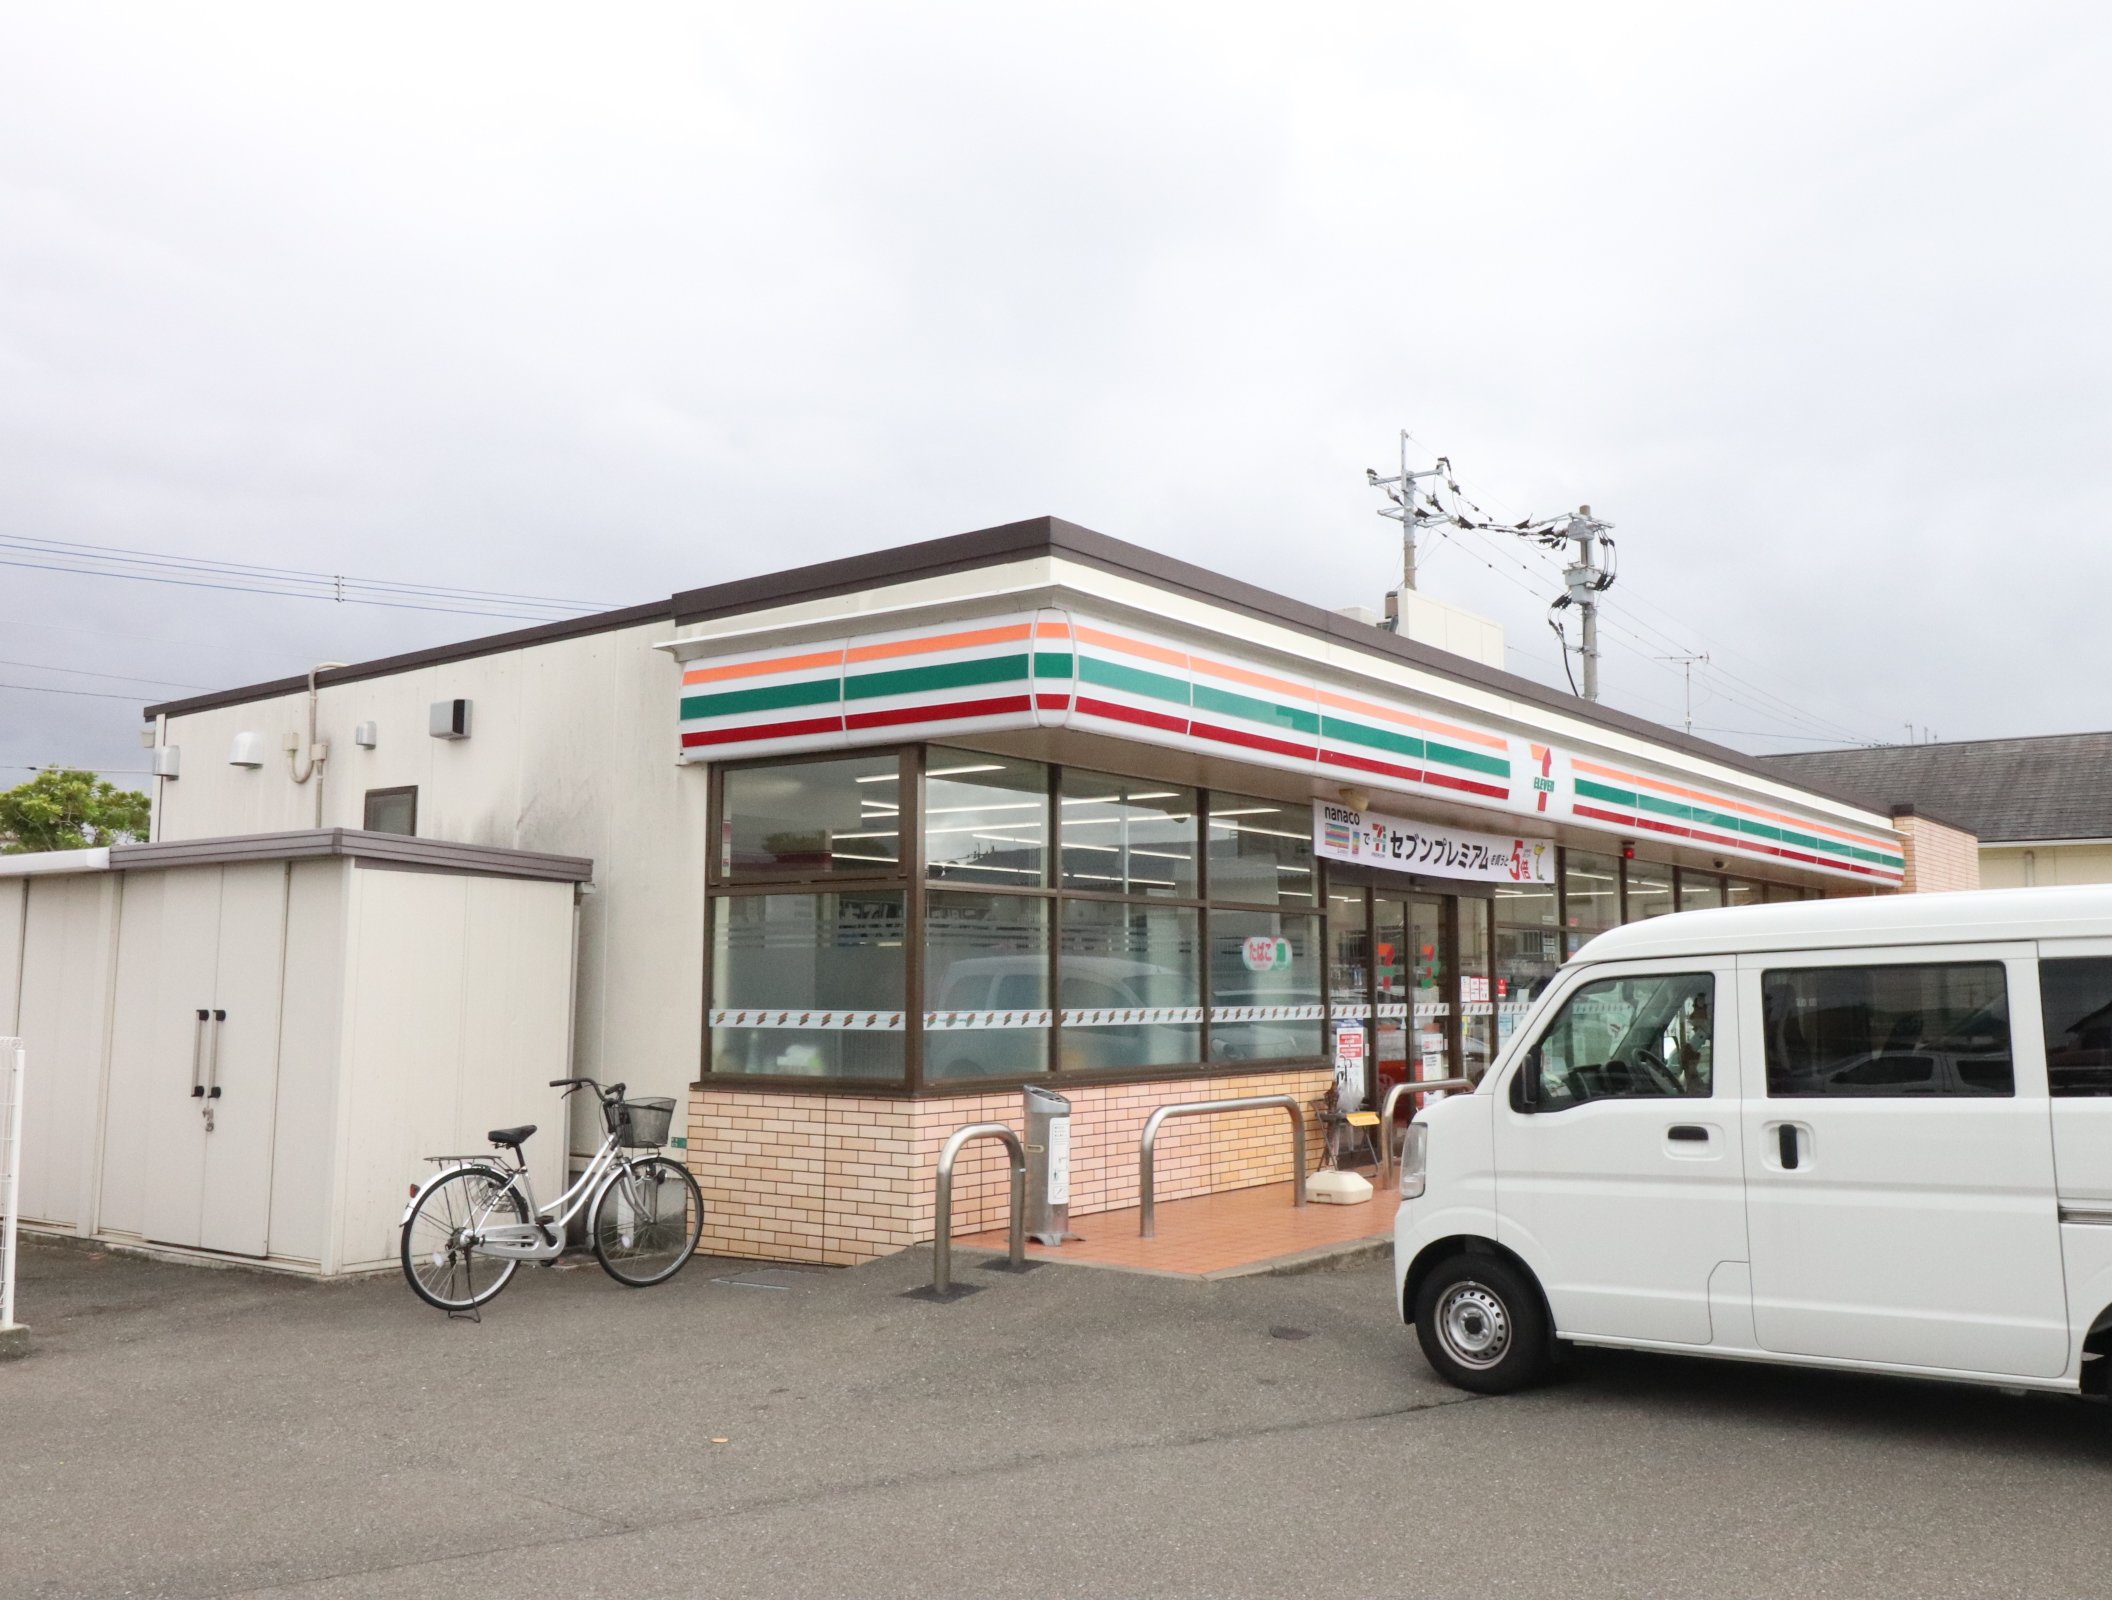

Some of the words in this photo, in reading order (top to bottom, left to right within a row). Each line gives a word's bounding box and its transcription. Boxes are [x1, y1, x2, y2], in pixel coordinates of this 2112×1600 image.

[1324, 806, 1361, 826] nanaco
[1363, 833, 1371, 846] で
[1390, 830, 1489, 871] セブンプレミアム
[1249, 942, 1272, 961] たばこ
